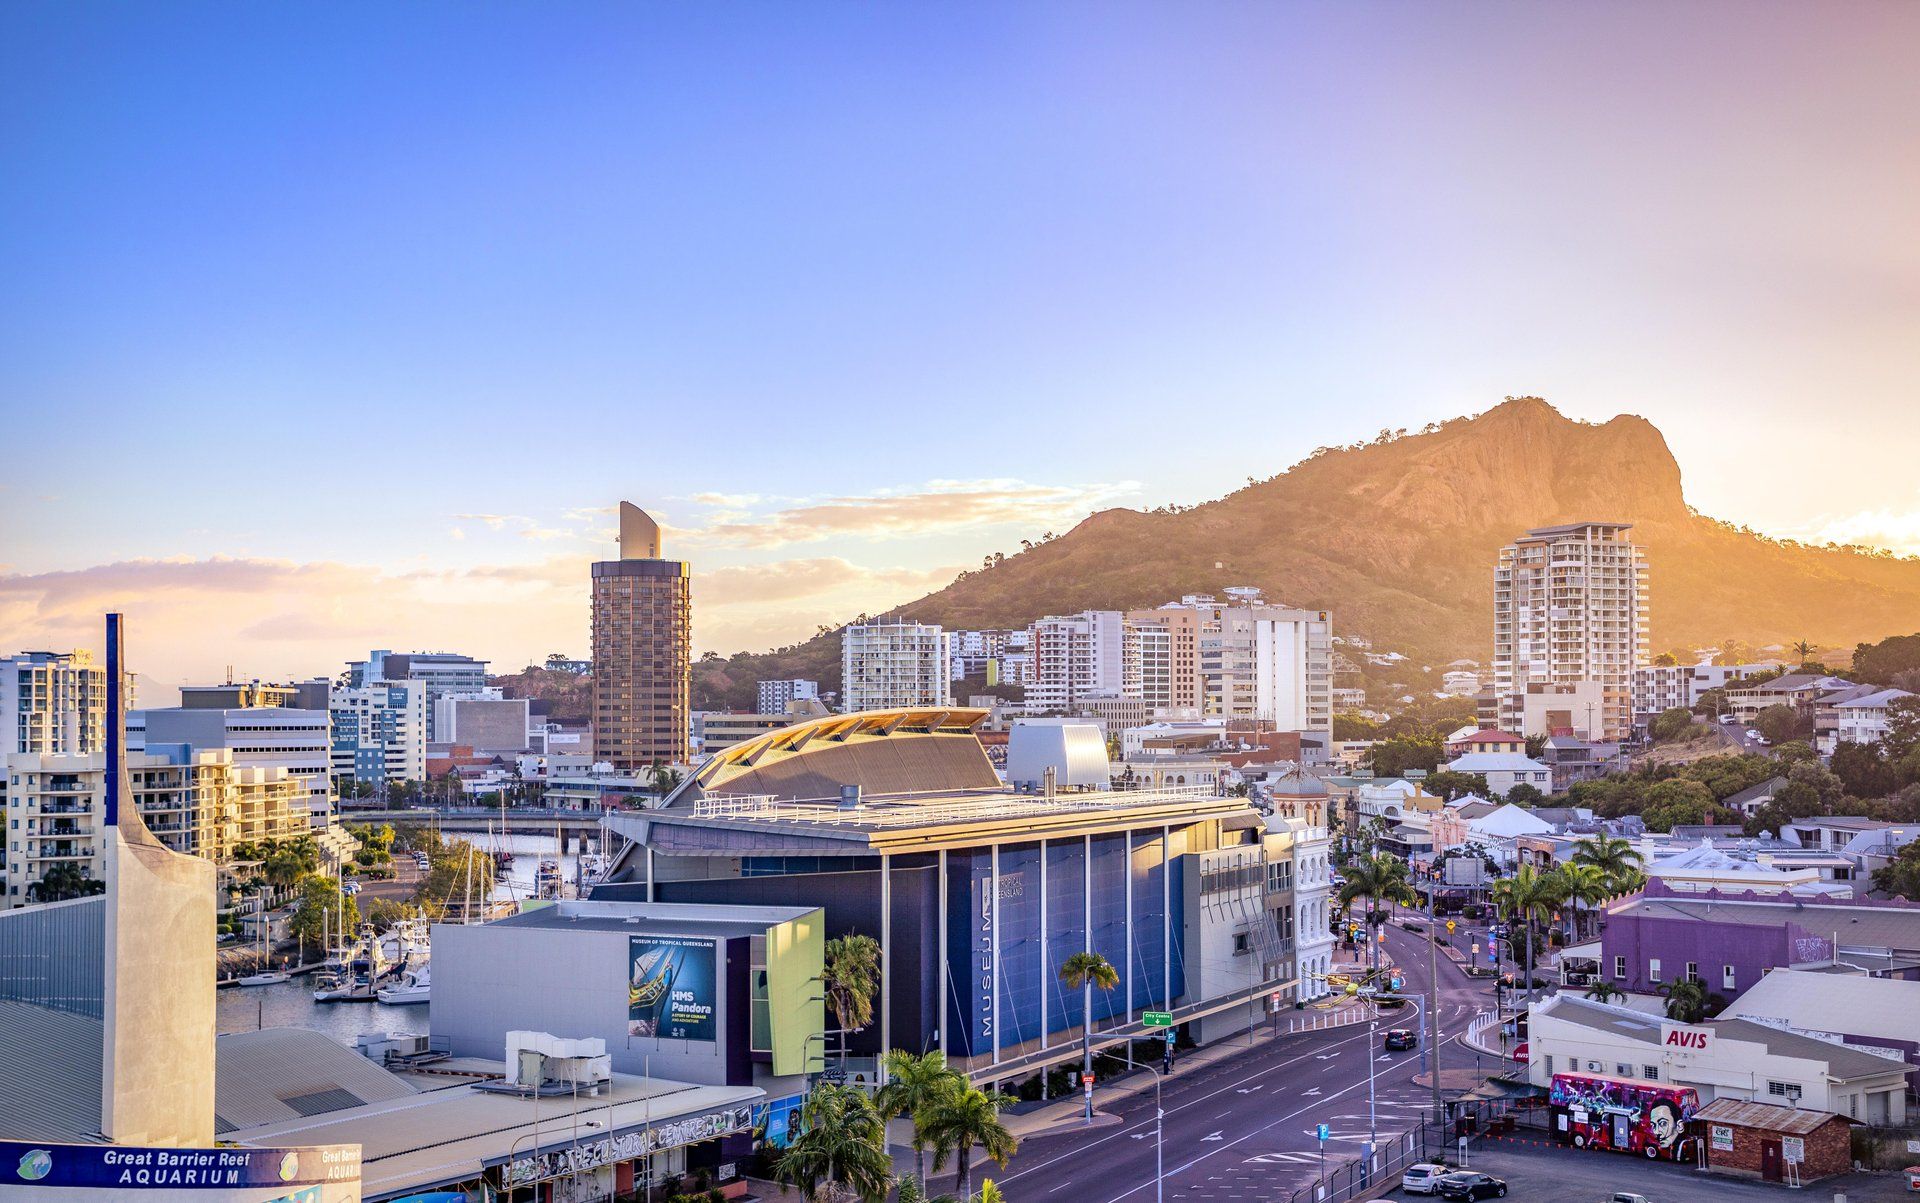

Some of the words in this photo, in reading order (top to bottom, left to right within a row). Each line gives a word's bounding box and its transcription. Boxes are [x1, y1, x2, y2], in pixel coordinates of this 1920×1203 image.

[982, 913, 993, 1037] MUSEUM
[672, 991, 694, 1001] HMS
[672, 1002, 712, 1014] Pandora
[1666, 1030, 1707, 1049] AVIS
[104, 1151, 152, 1165] Great
[158, 1152, 215, 1166] Barrier
[219, 1153, 250, 1166] Reef
[119, 1169, 239, 1184] AQUARIUM
